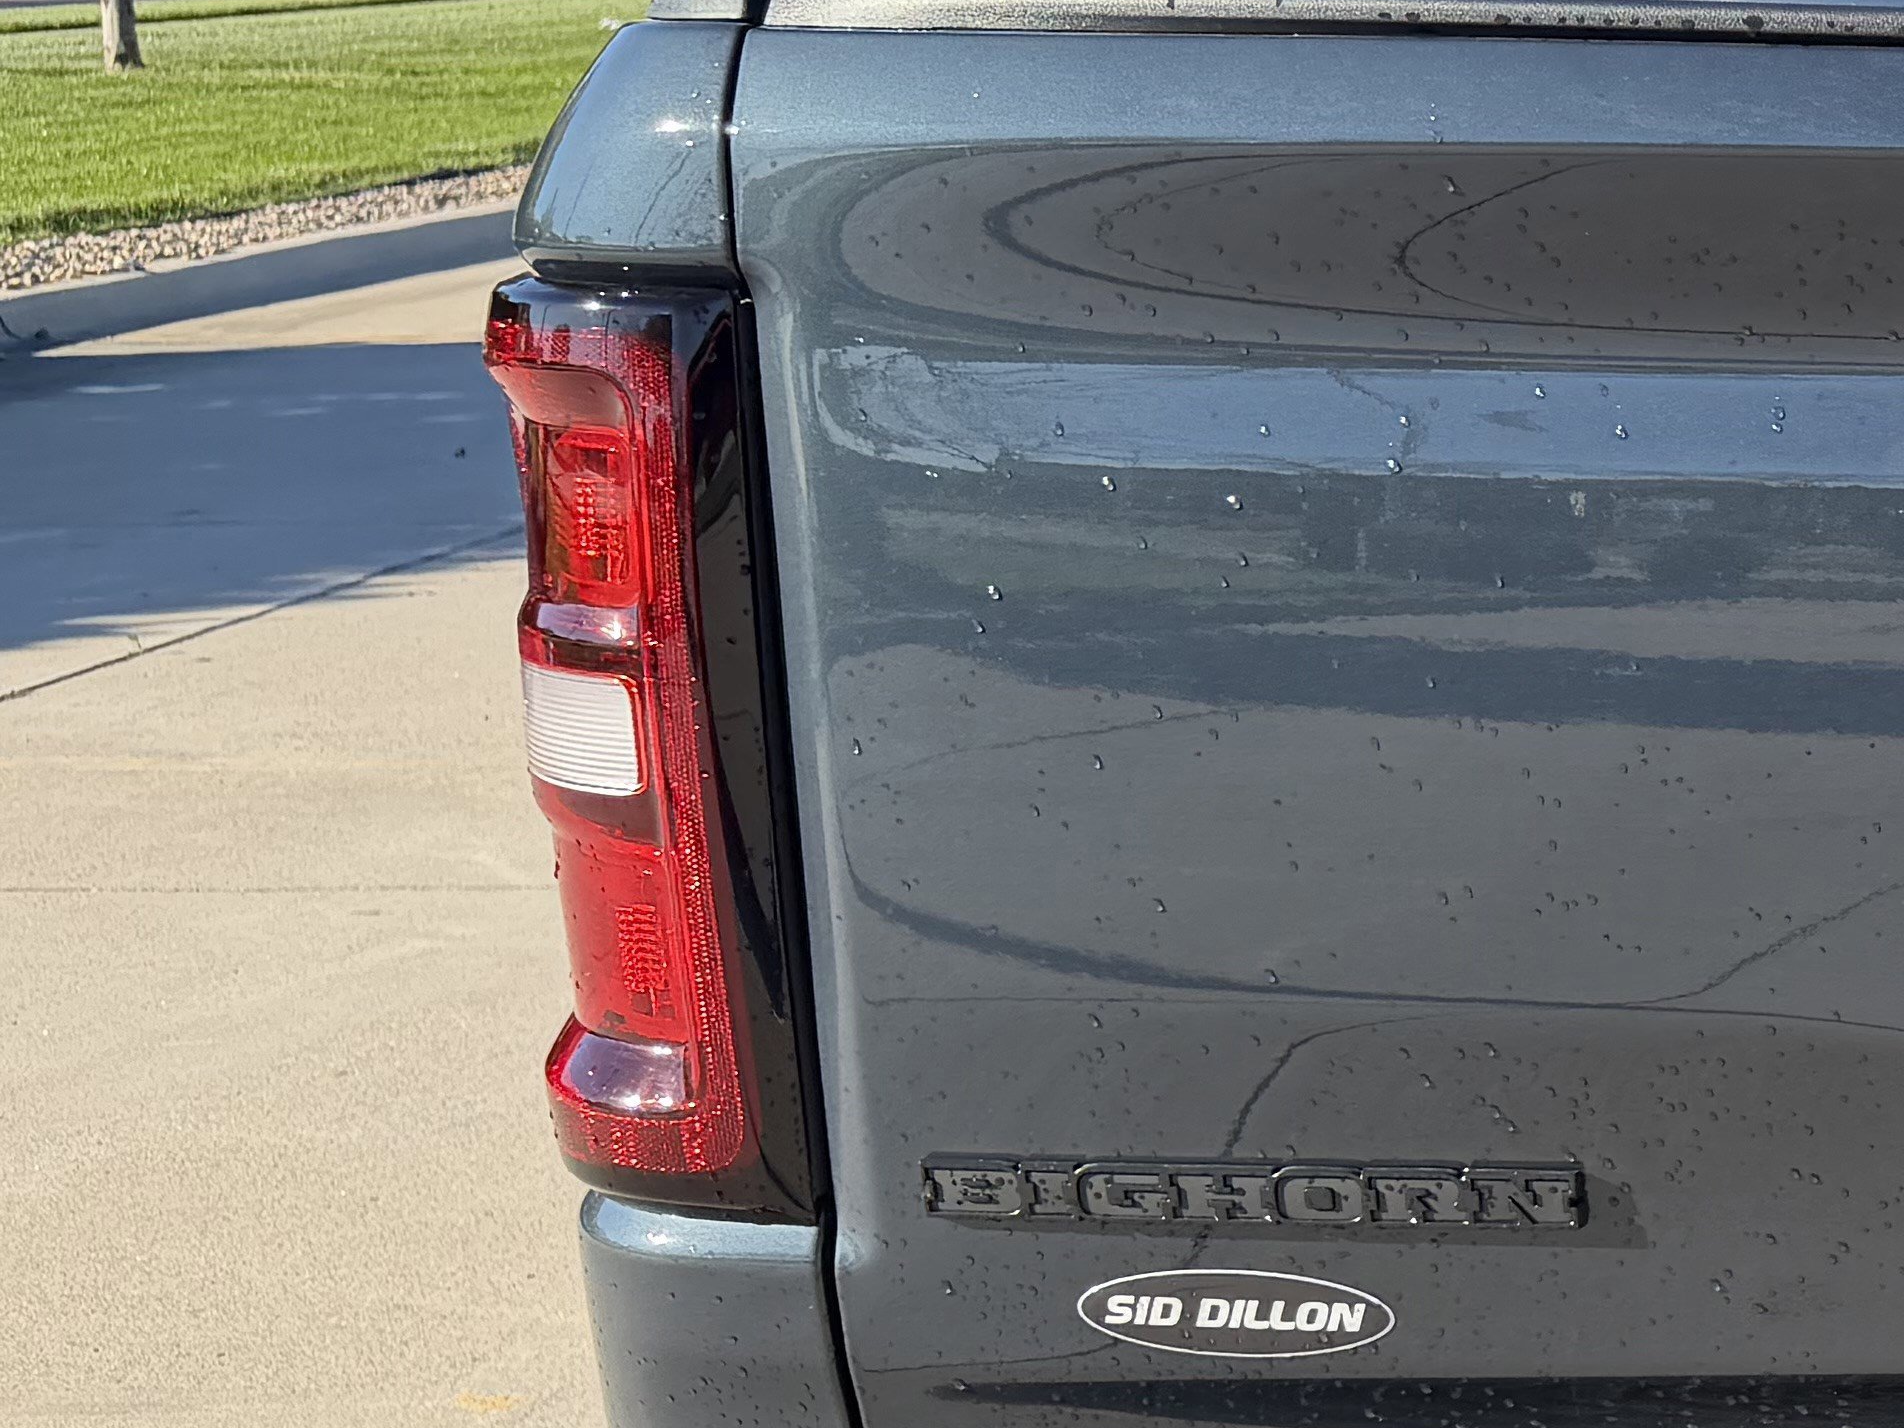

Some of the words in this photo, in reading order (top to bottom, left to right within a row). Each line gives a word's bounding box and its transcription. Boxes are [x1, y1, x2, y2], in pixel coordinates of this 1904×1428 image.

[922, 1152, 1587, 1229] BIGHORN
[1104, 1294, 1184, 1327] SID
[1196, 1296, 1366, 1334] DILLON
